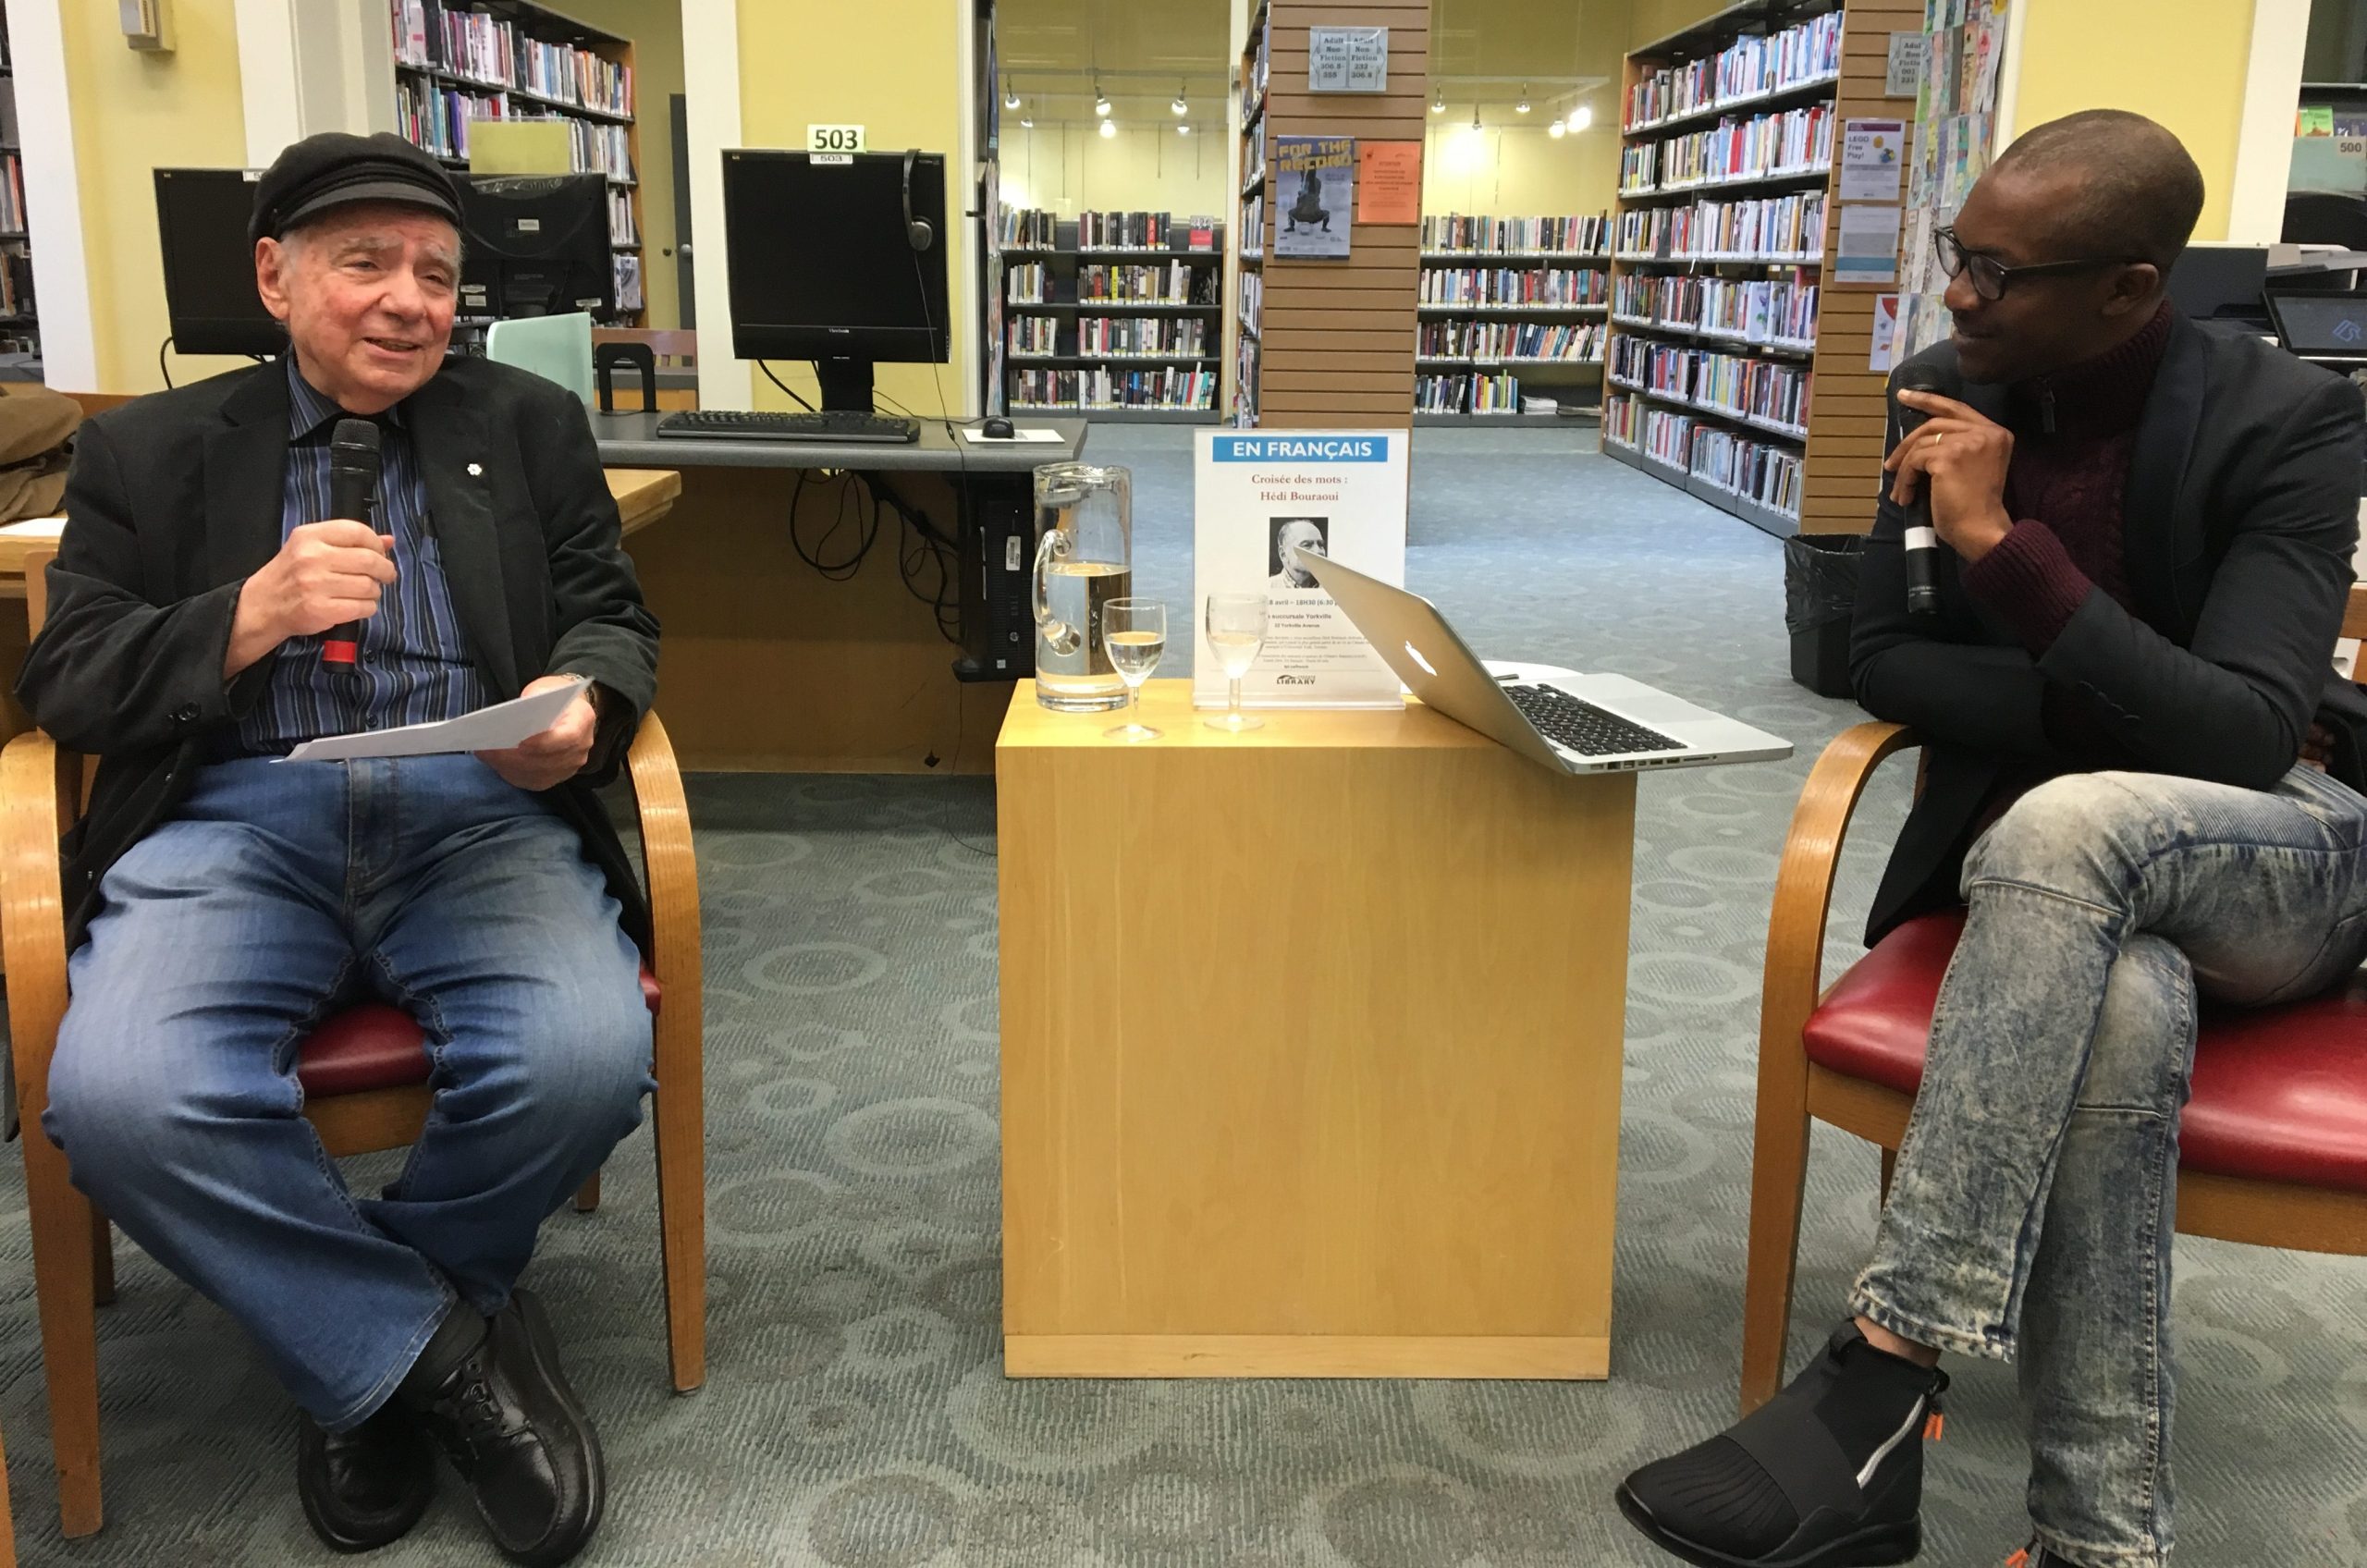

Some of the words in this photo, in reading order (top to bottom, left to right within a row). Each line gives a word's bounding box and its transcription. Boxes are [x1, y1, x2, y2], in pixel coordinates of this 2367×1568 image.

[815, 129, 858, 150] 503
[2340, 141, 2362, 153] 500
[1279, 144, 1311, 156] FOR
[1318, 140, 1351, 153] THE
[1281, 154, 1352, 171] RECORD
[1233, 441, 1261, 457] EN
[1267, 441, 1373, 459] FRANÇAIS
[1251, 473, 1292, 484] Croisée
[1294, 473, 1313, 484] des
[1315, 475, 1342, 484] mots
[1260, 491, 1287, 501] Hédi
[1290, 491, 1339, 501] Bouraoui
